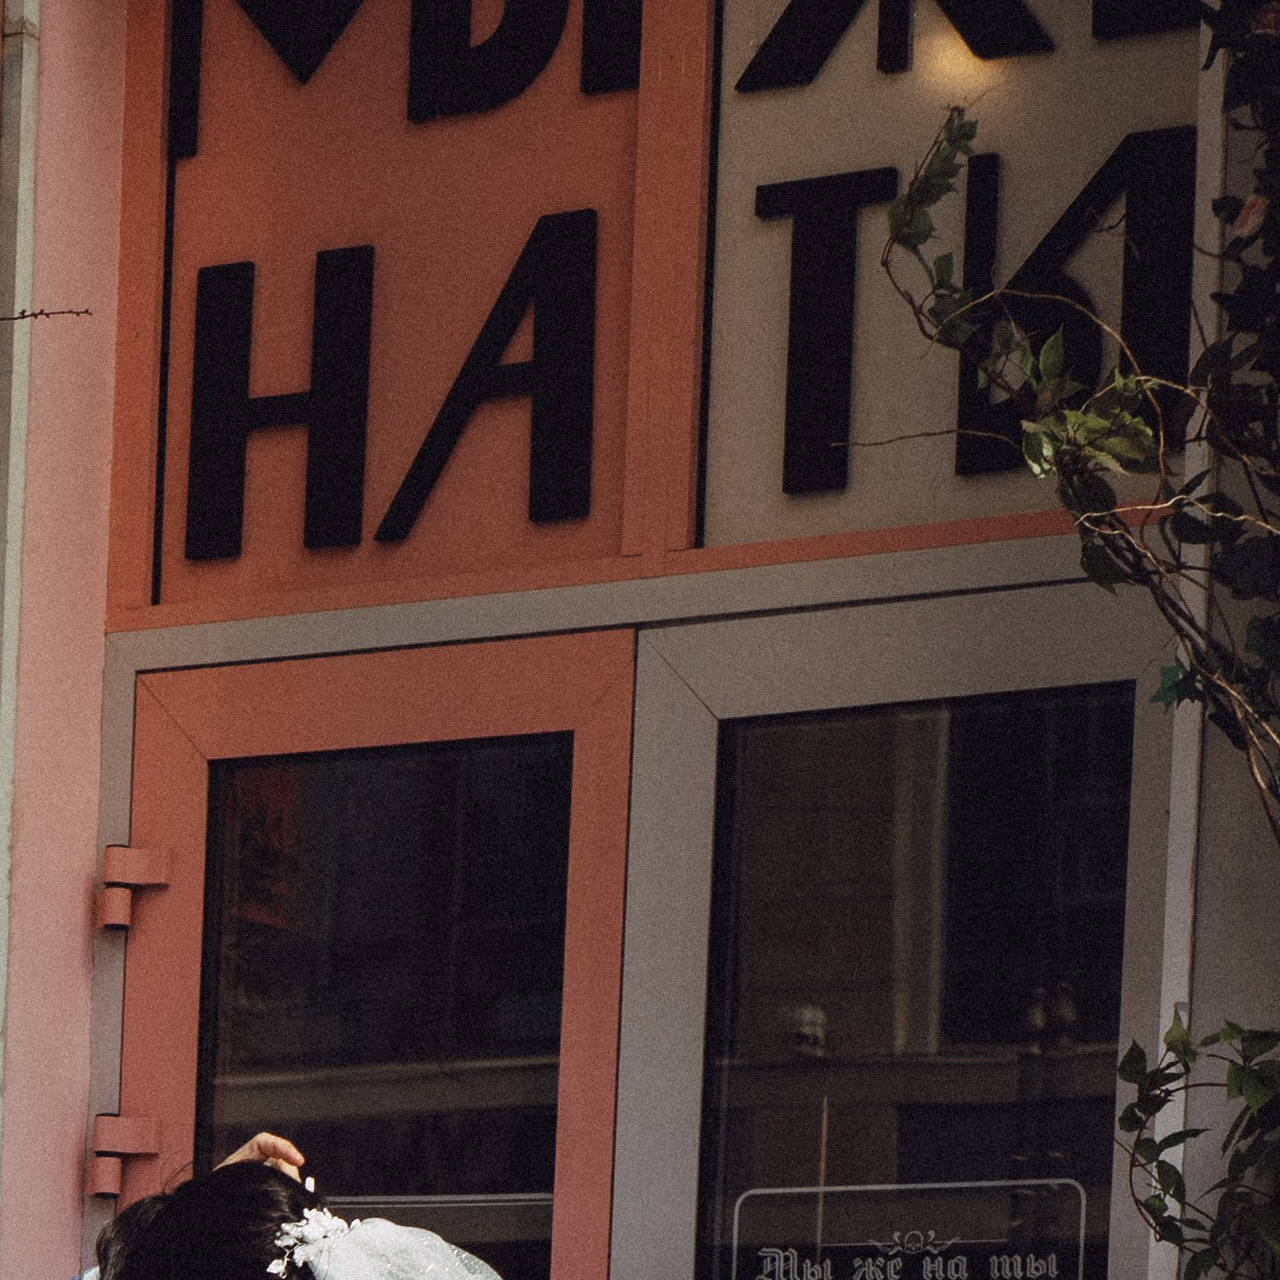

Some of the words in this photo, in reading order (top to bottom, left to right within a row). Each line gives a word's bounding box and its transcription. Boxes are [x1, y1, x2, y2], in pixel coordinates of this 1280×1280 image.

[185, 208, 598, 560] НА
[755, 125, 1197, 496] ТЫ
[922, 1255, 968, 1280] на
[989, 1253, 1058, 1279] ты
